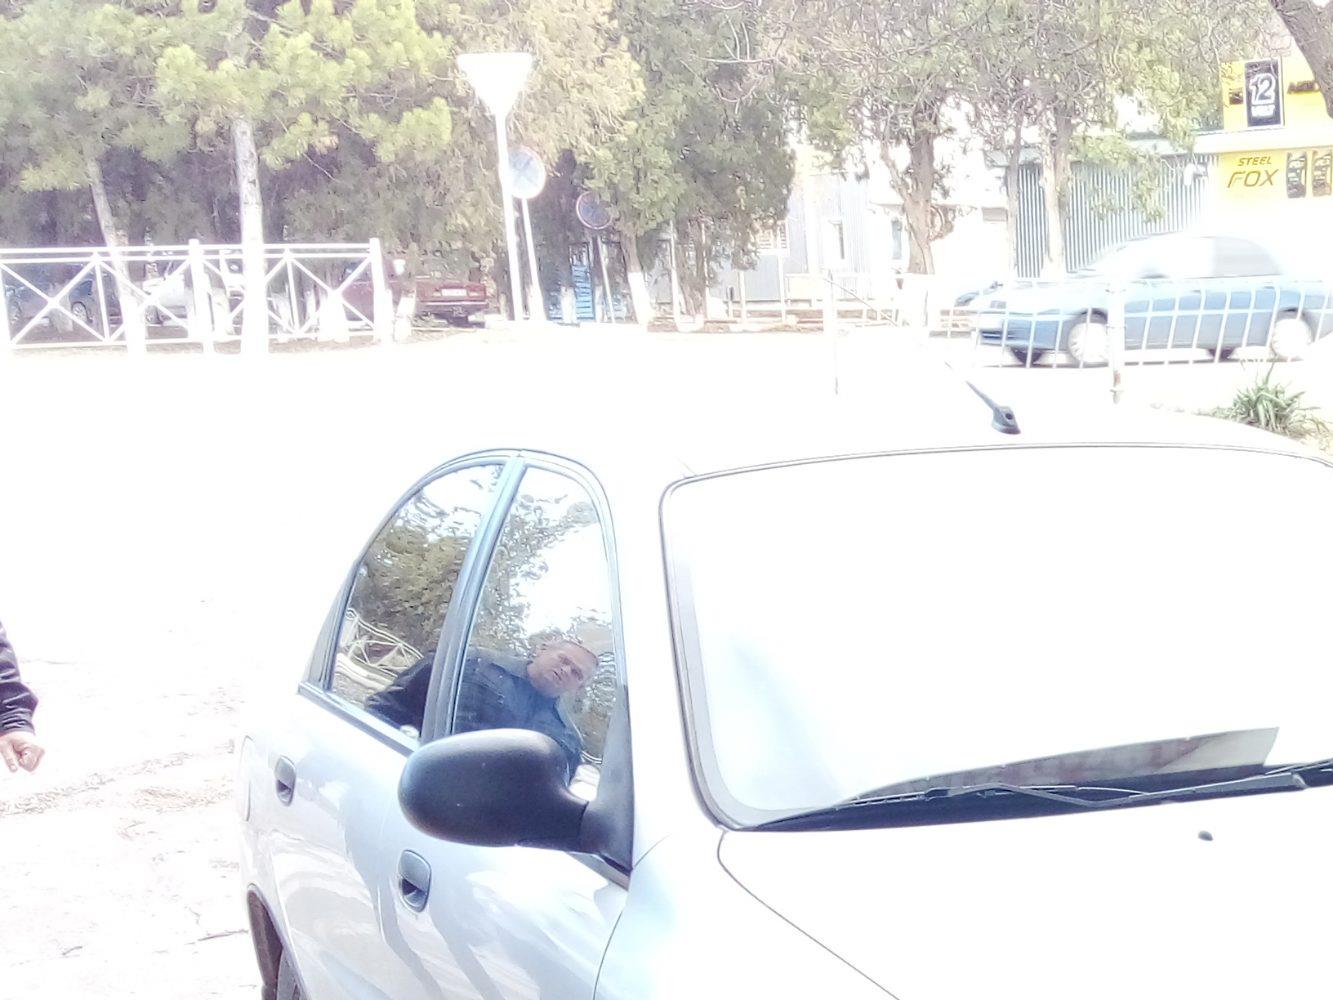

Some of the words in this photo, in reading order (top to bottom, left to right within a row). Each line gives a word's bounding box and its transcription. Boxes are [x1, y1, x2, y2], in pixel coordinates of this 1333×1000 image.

[1249, 73, 1276, 105] 12
[1238, 156, 1272, 167] STEEL
[1227, 169, 1280, 188] FOX
